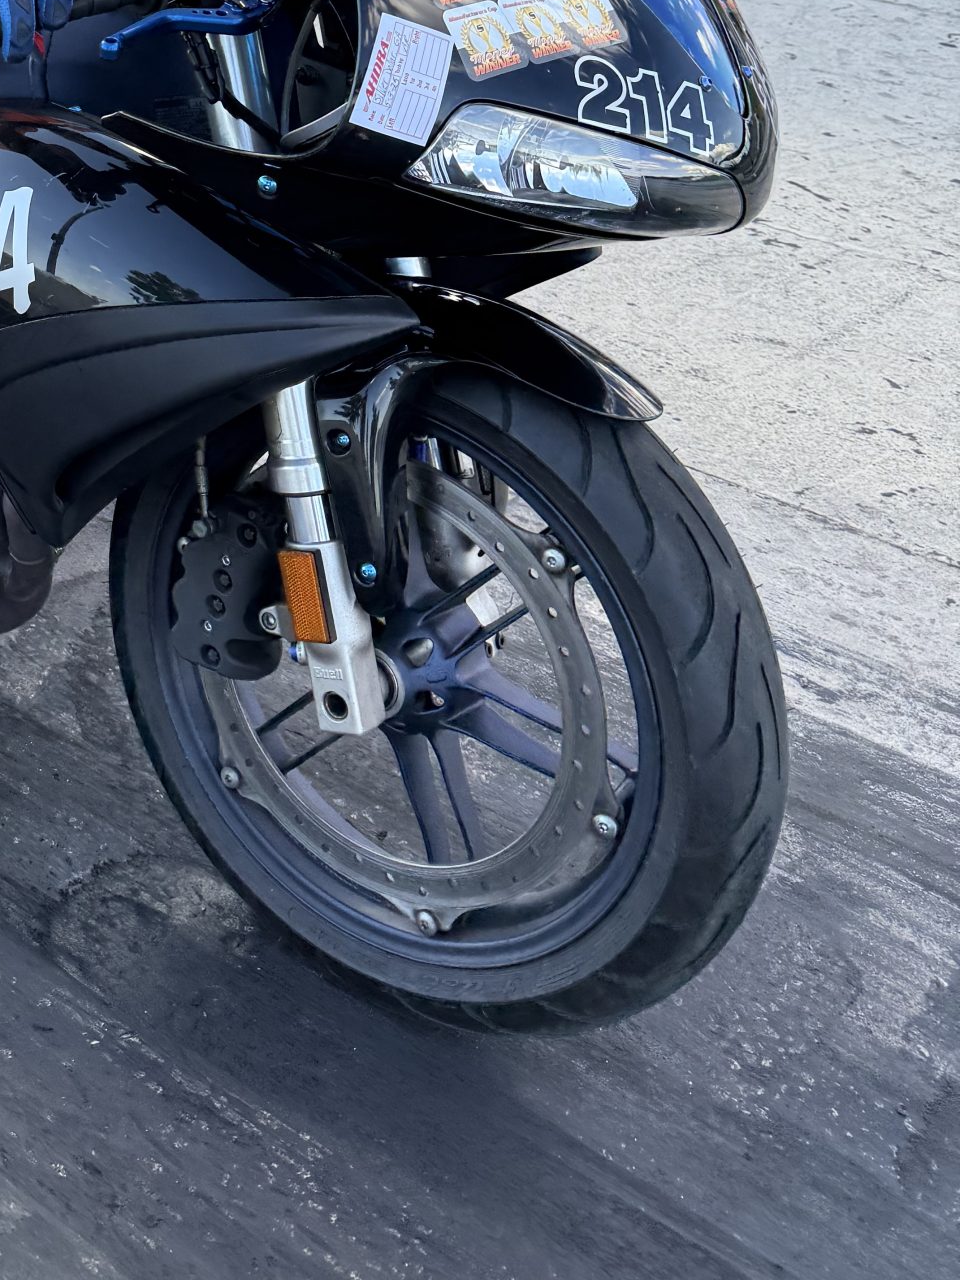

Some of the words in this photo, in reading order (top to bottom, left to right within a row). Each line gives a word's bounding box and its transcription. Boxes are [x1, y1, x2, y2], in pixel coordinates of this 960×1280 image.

[473, 53, 521, 77] WINNER
[531, 40, 573, 59] WINNER
[366, 40, 390, 104] AHDRA
[574, 55, 715, 157] 214
